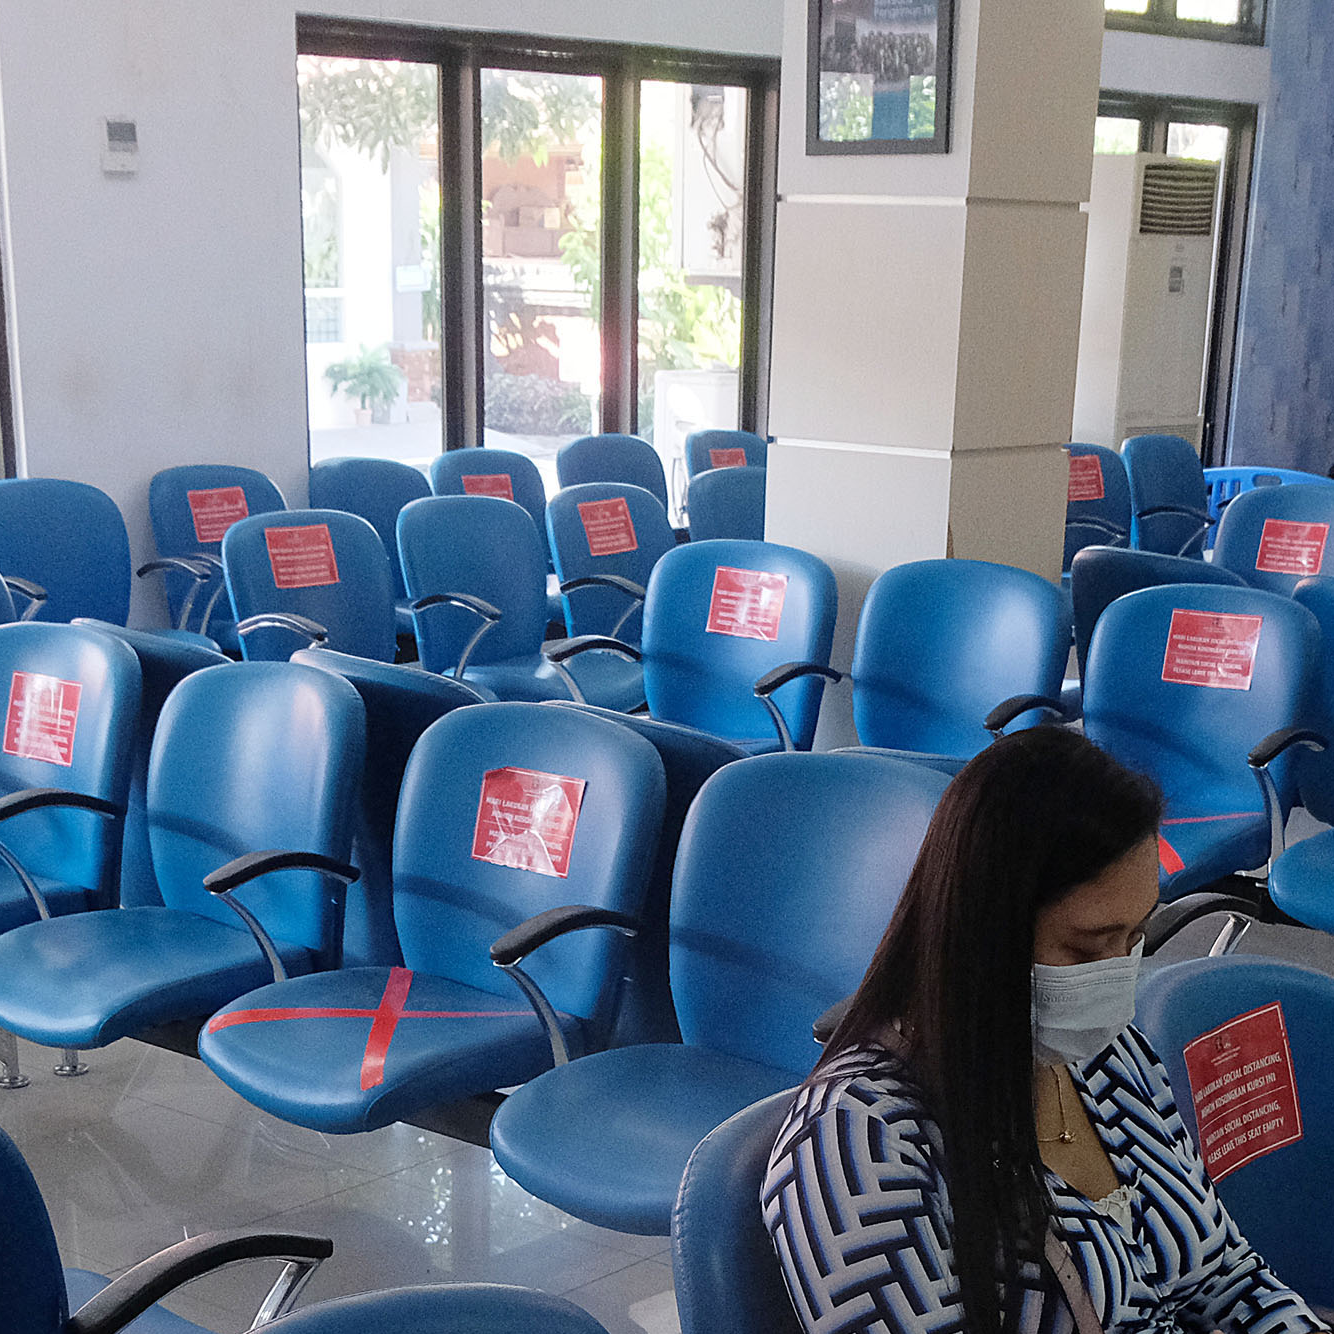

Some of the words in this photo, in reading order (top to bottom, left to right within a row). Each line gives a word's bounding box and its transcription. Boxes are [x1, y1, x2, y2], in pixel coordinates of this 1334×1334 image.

[1223, 1068, 1243, 1085] SOCIAL
[1247, 1125, 1262, 1141] SEAT
[1262, 1116, 1284, 1134] EMPTY
